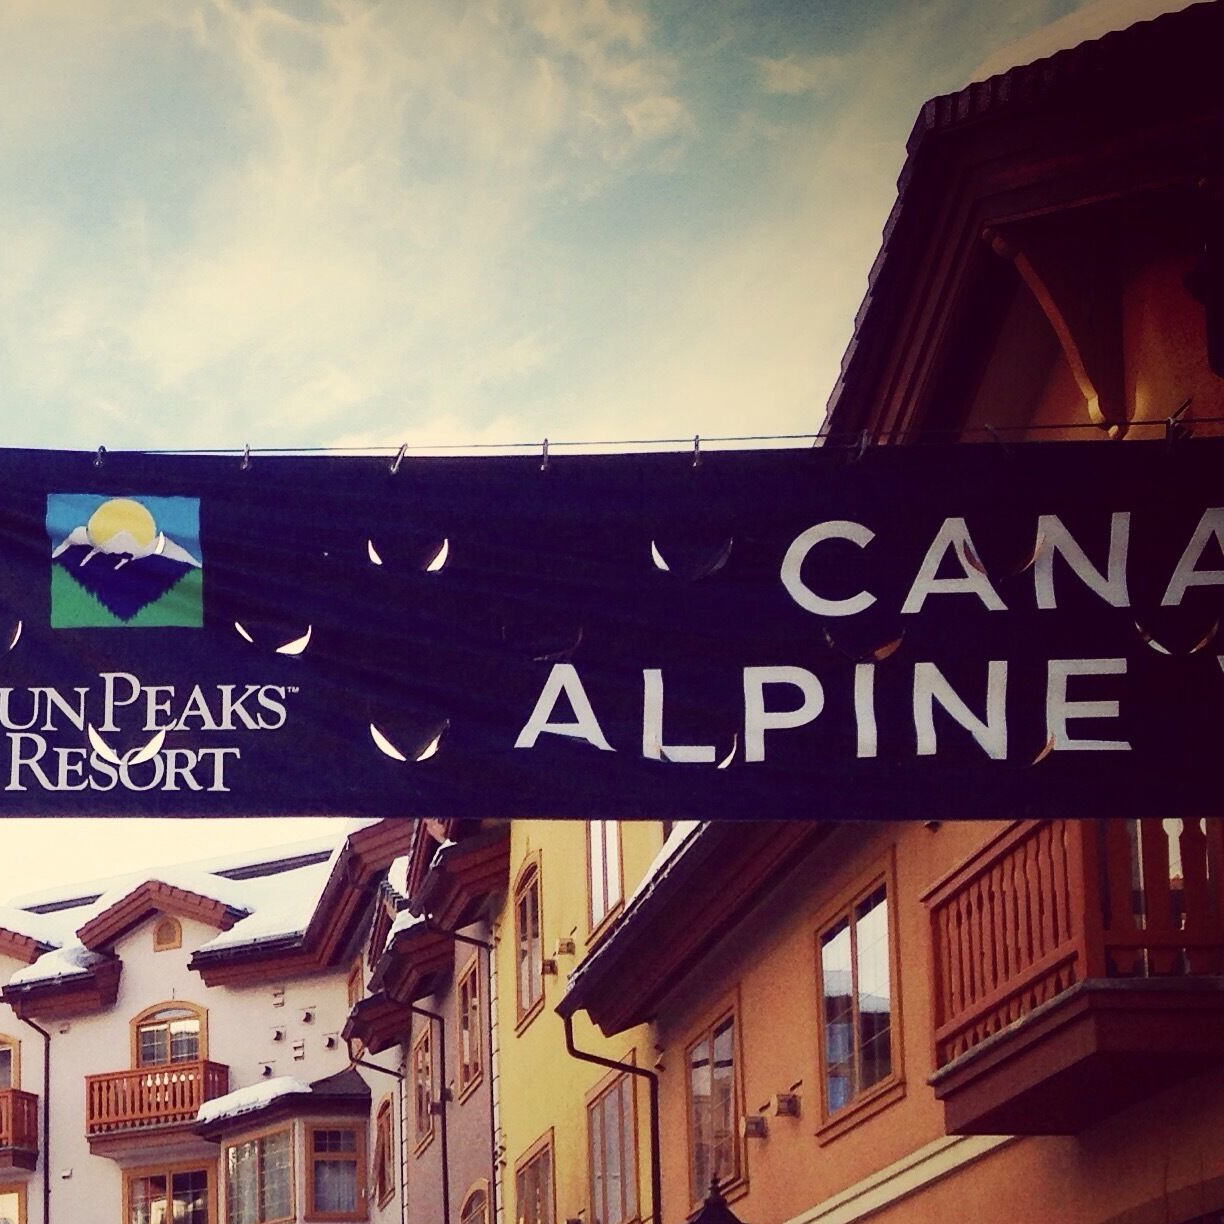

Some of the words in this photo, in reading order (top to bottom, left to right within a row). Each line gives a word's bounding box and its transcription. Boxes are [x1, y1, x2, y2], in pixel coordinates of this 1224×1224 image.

[780, 507, 1224, 617] CANA
[4, 732, 241, 792] RESORT
[513, 657, 1132, 764] ALPINE
